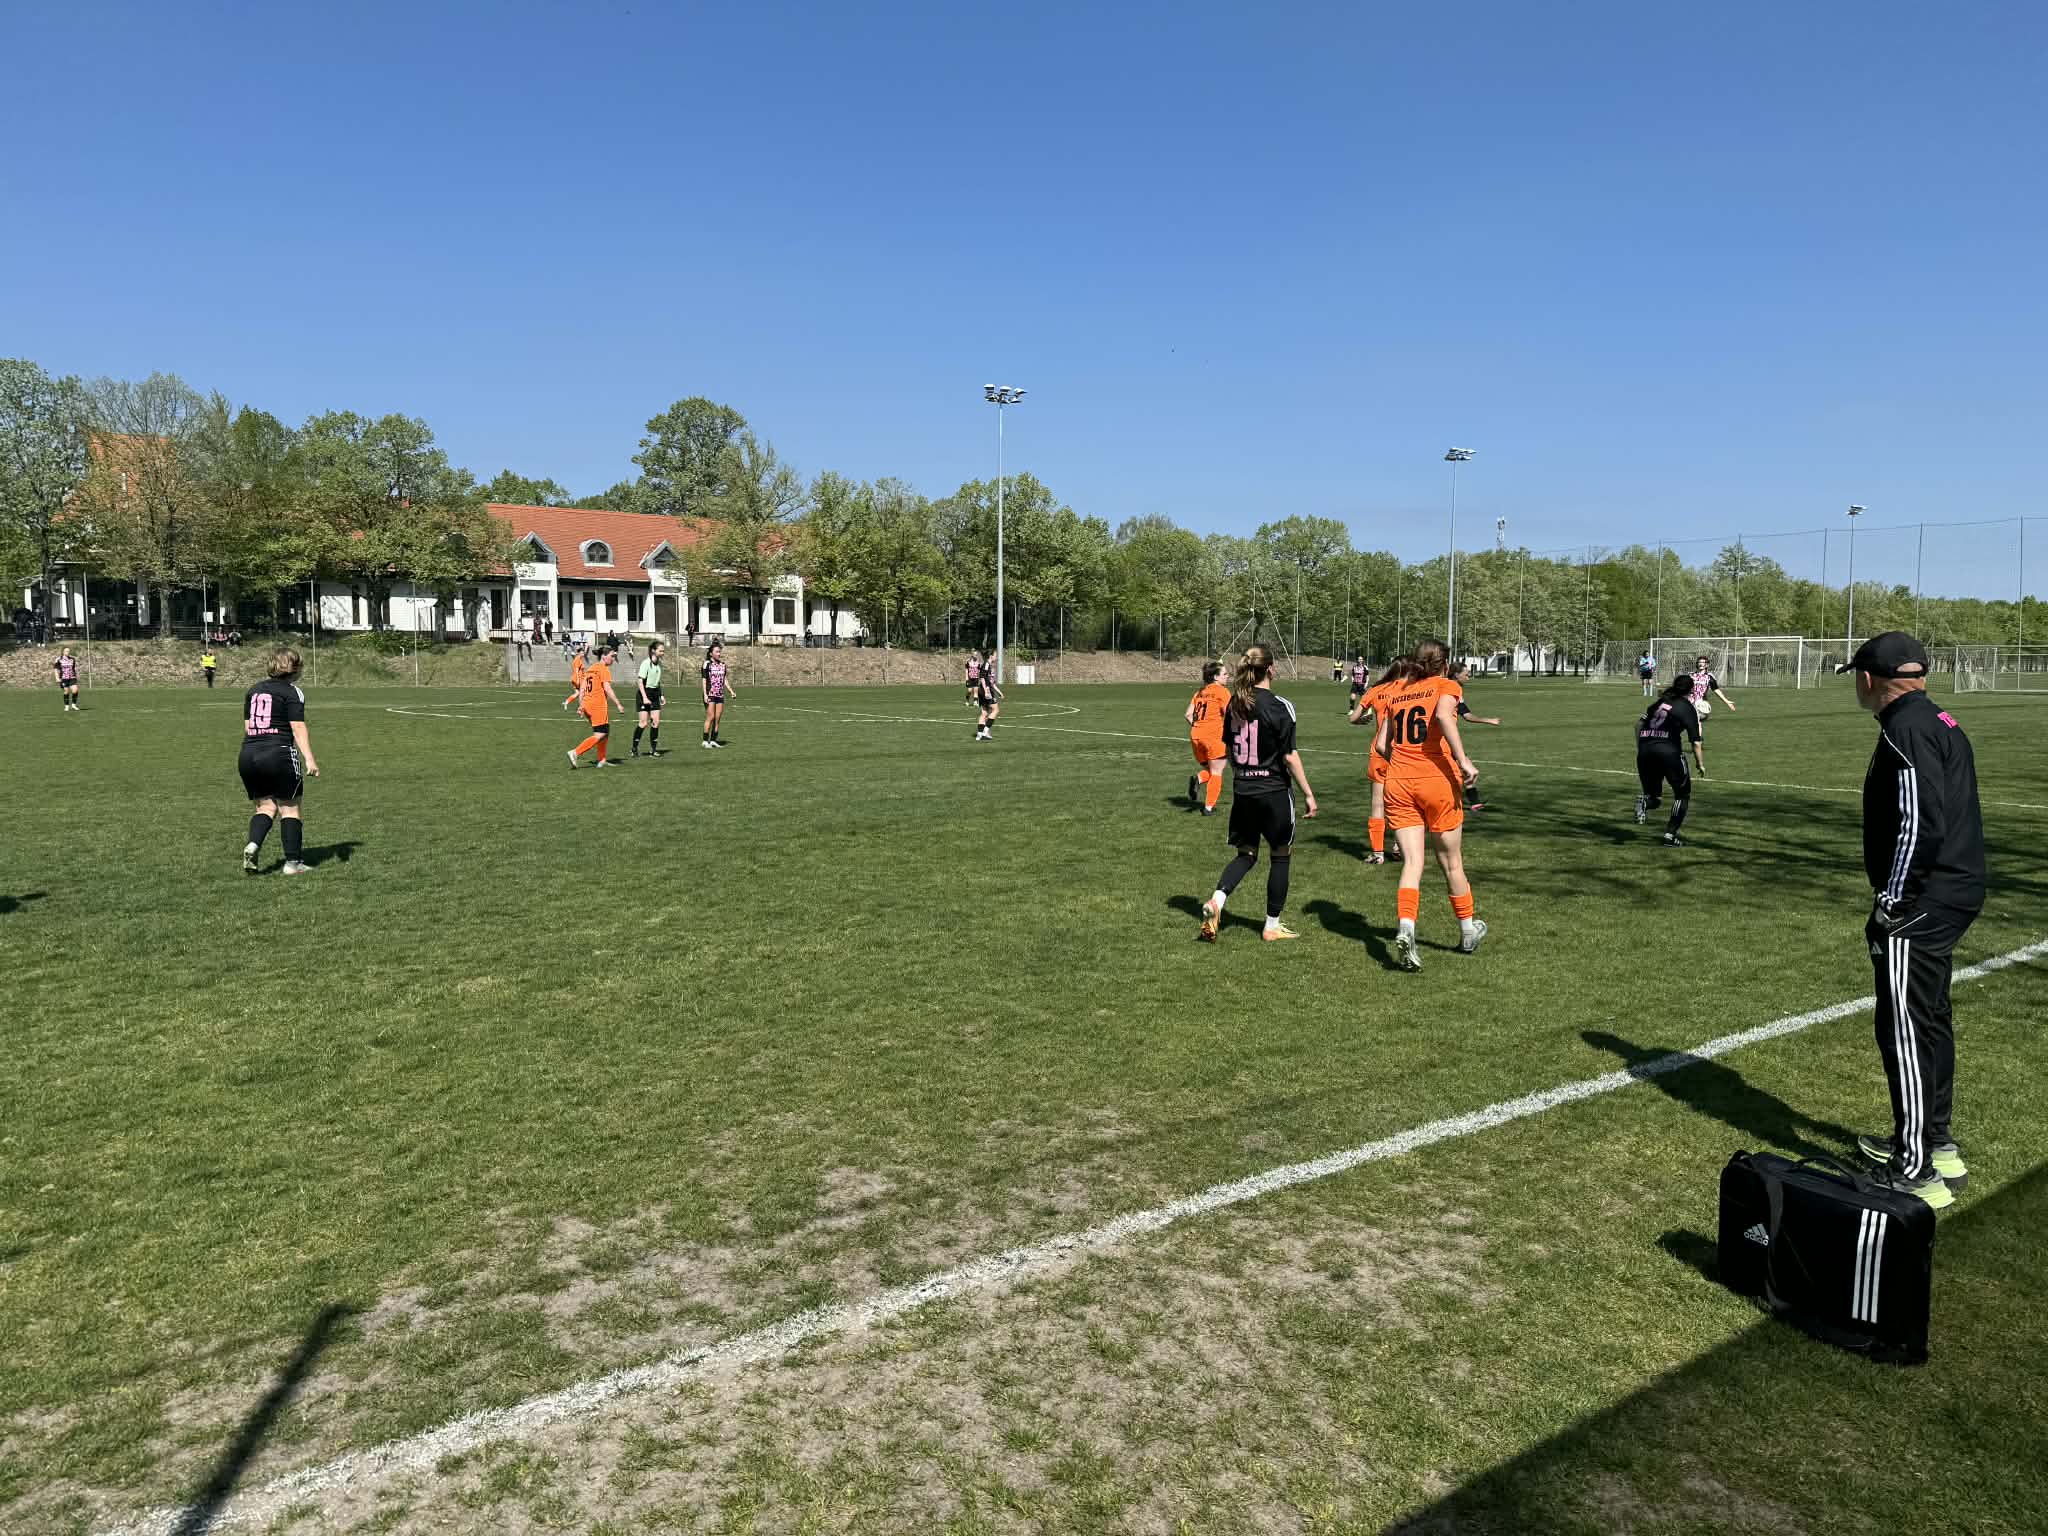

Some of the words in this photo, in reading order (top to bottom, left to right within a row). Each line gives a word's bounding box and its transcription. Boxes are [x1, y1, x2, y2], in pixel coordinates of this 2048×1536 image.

[249, 693, 272, 729] 19
[1394, 705, 1427, 744] 16
[1231, 719, 1259, 766] 31
